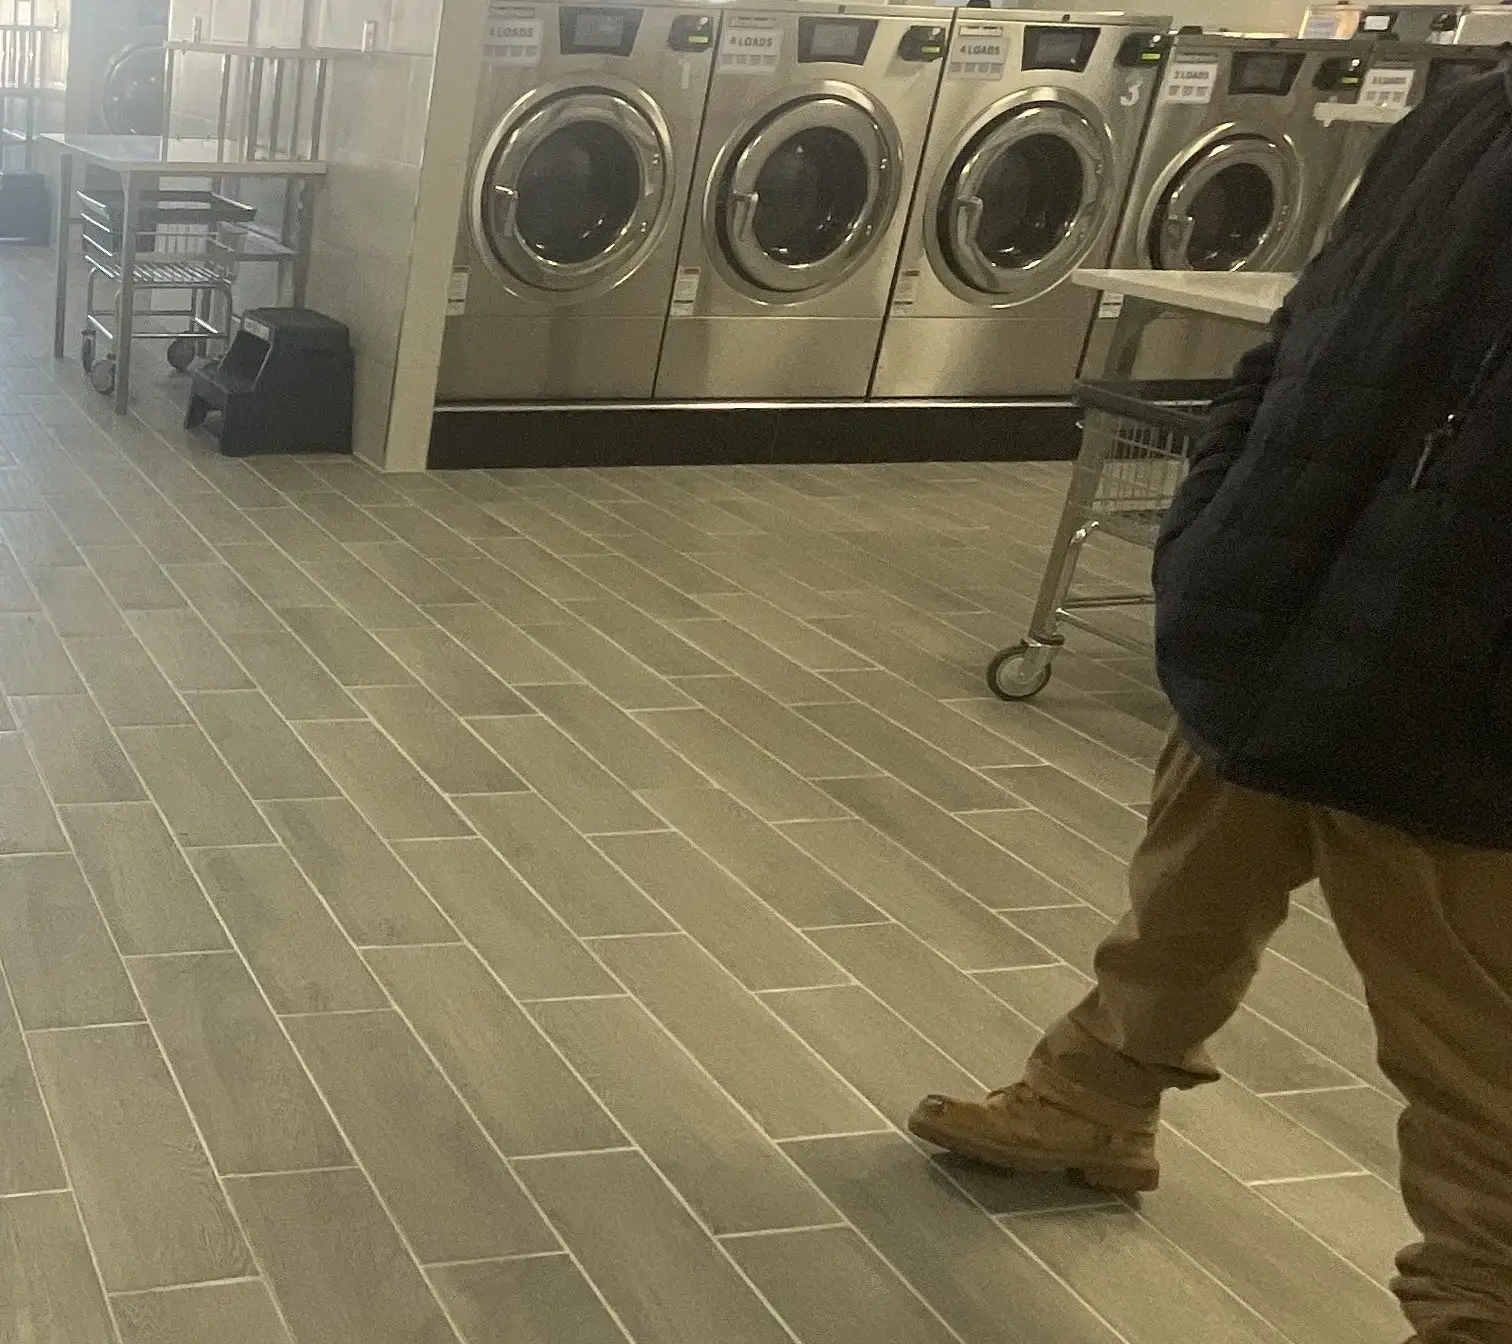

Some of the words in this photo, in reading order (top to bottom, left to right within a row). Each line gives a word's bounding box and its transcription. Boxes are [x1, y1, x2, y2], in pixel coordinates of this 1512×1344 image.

[496, 26, 535, 38] LOADS
[737, 36, 773, 47] LOADS
[968, 44, 1001, 55] LOADS
